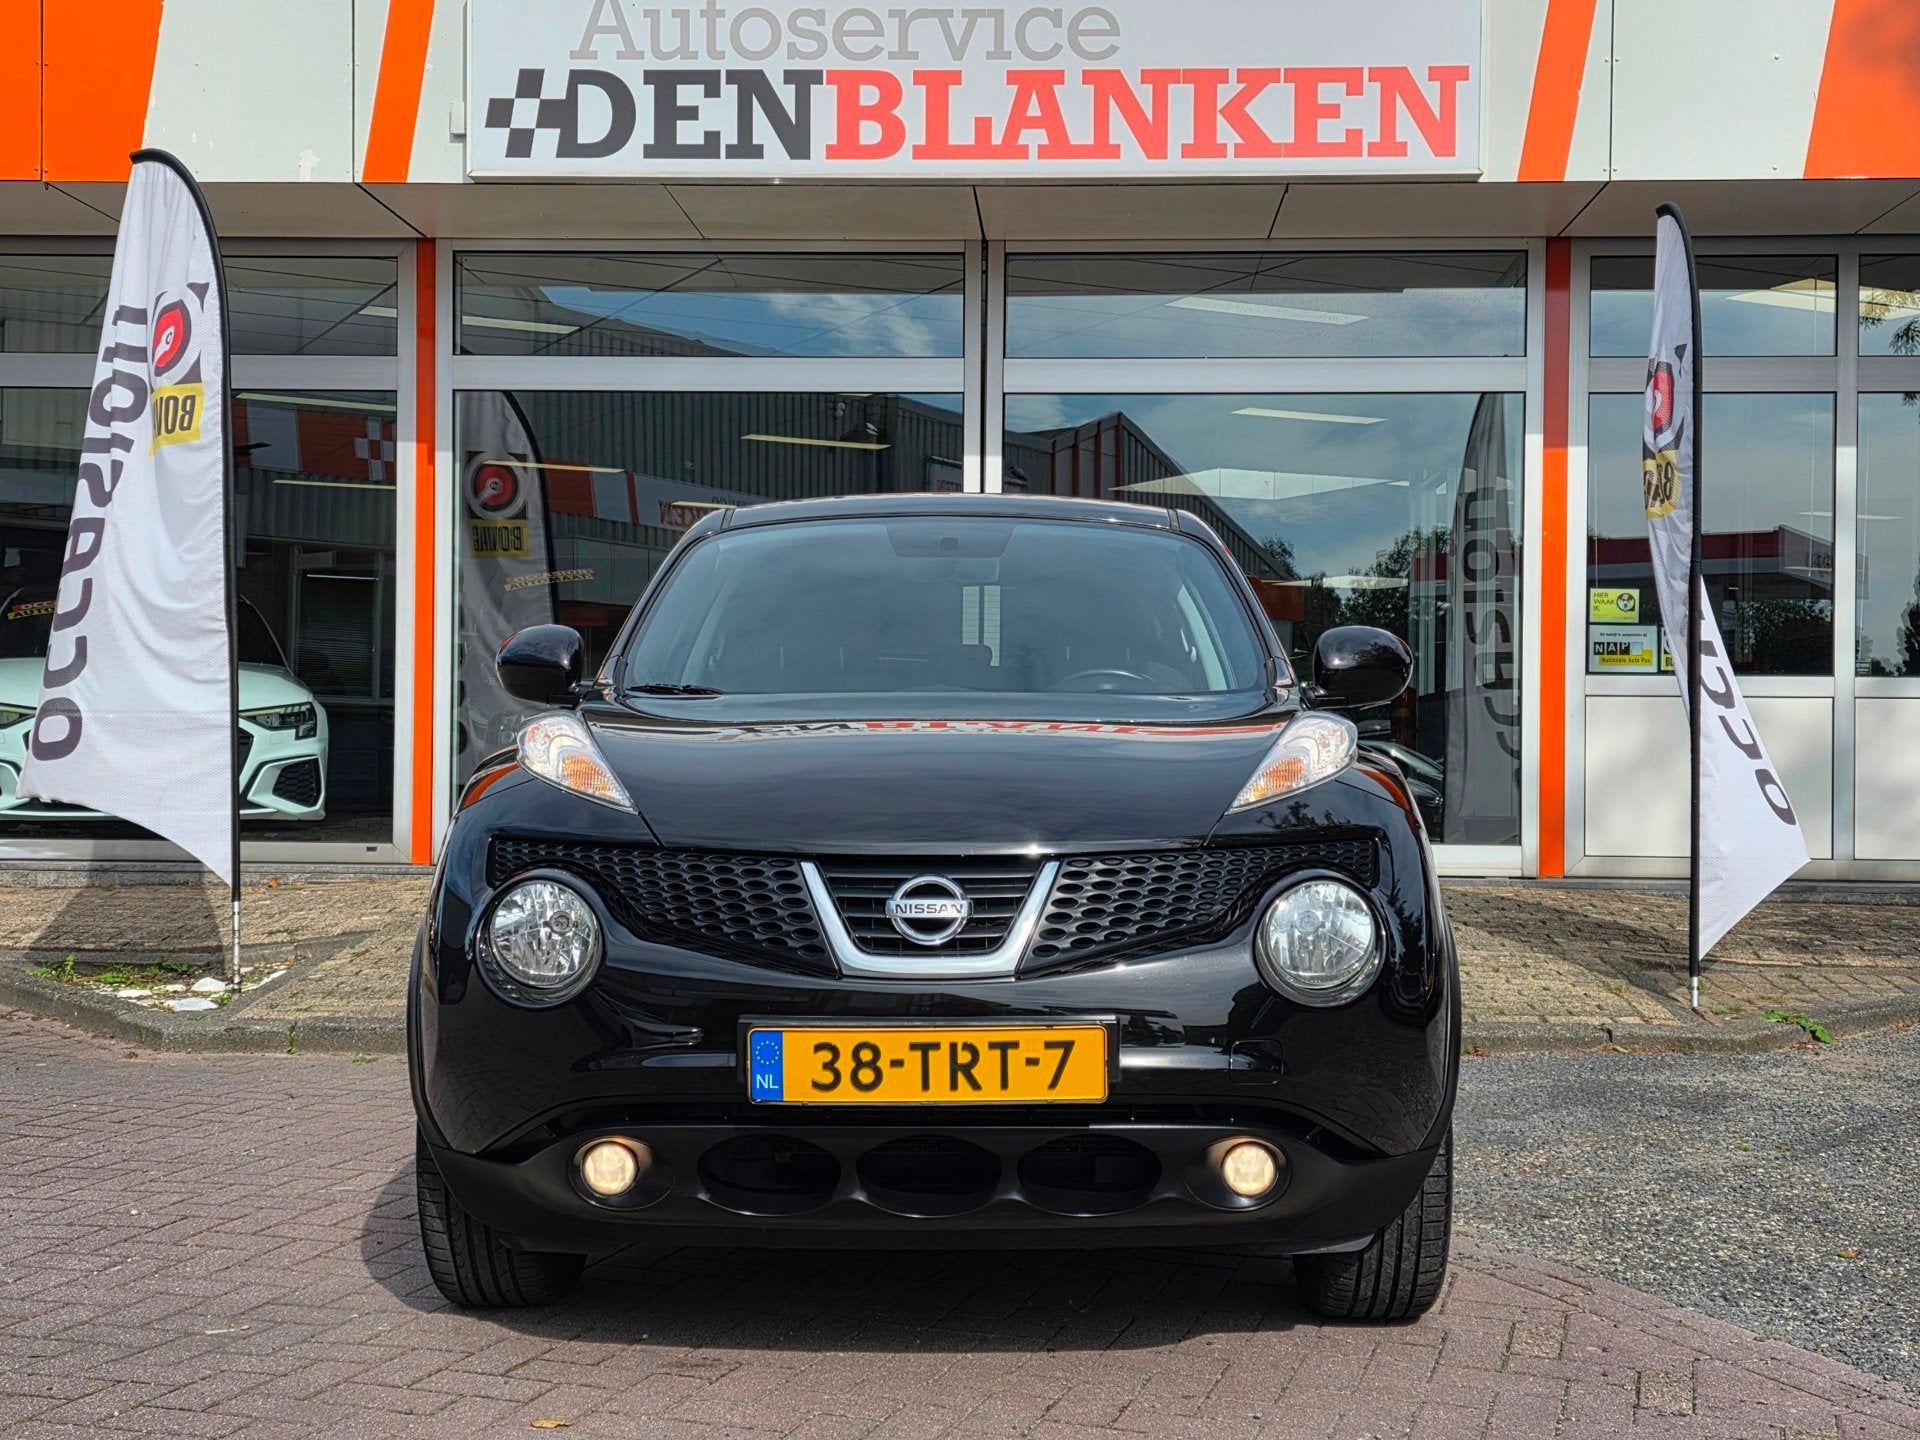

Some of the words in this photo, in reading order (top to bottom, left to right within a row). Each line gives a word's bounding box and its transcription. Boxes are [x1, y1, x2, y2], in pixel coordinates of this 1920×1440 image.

[570, 0, 1121, 61] Autoservice
[895, 903, 964, 915] NISSAN
[755, 1073, 779, 1089] NL
[810, 1039, 1076, 1094] 38-TRT-7
